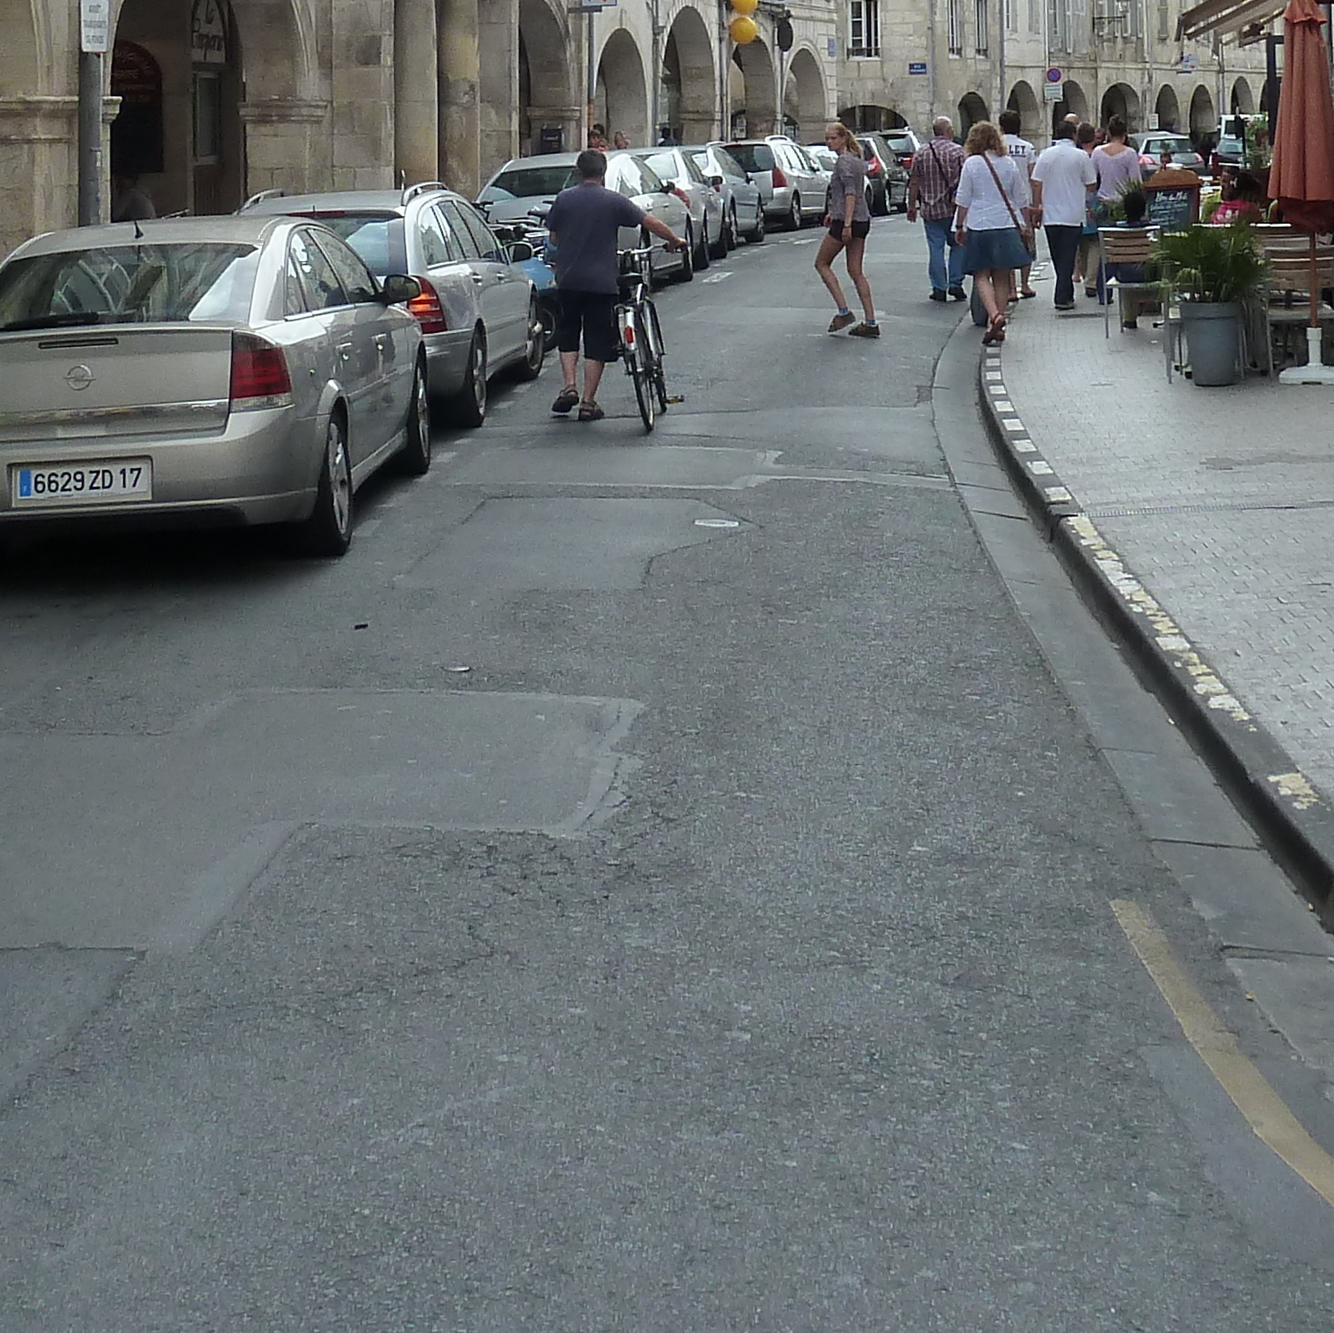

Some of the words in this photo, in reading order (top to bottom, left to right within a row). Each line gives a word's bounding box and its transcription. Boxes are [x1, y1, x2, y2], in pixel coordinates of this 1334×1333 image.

[34, 470, 85, 494] 6629
[89, 469, 113, 490] ZD
[119, 467, 142, 489] 17
